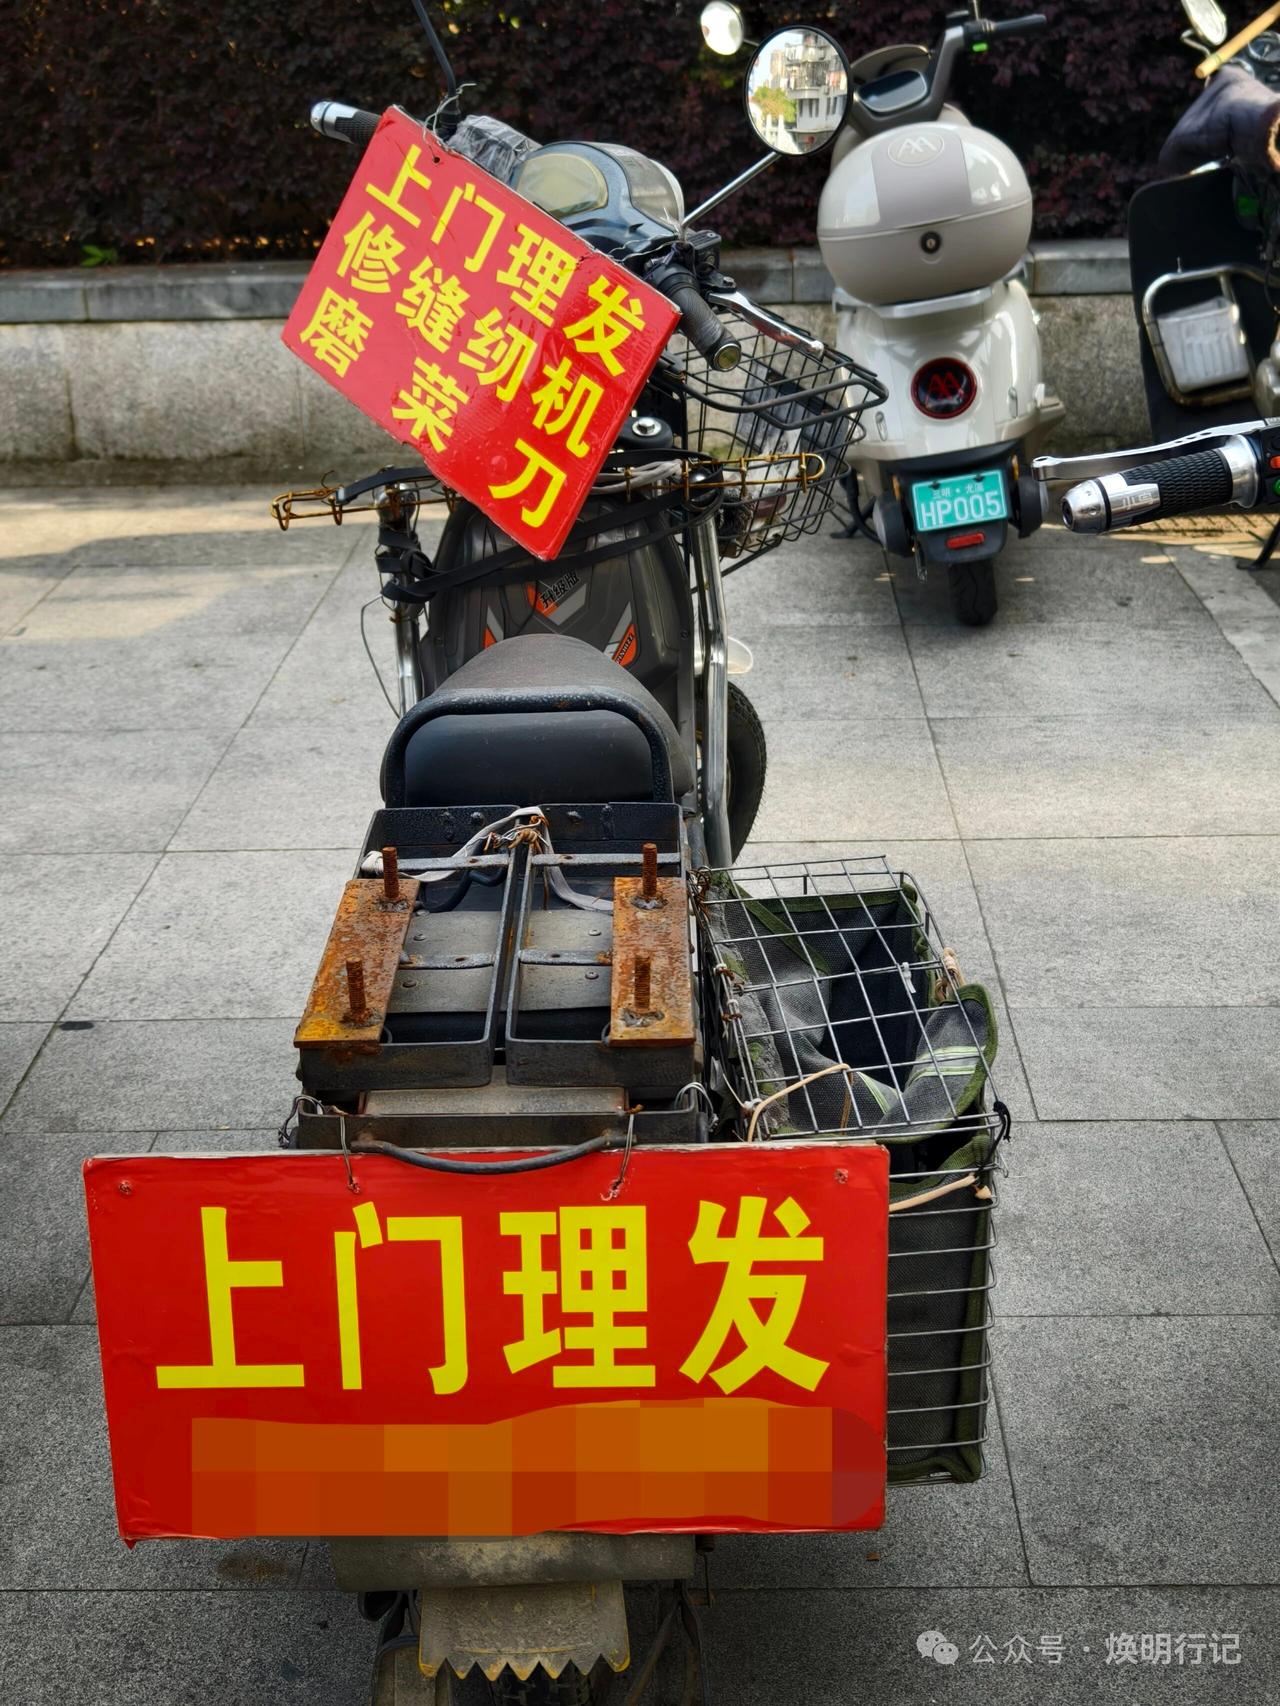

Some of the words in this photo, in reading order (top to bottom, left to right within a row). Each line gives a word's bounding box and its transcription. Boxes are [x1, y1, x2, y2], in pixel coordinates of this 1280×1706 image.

[336, 212, 604, 458] 修缝纫机
[365, 144, 645, 376] 上门理发
[540, 571, 580, 608] 升级版
[920, 491, 1001, 528] HP005
[156, 1196, 829, 1395] 上门理发
